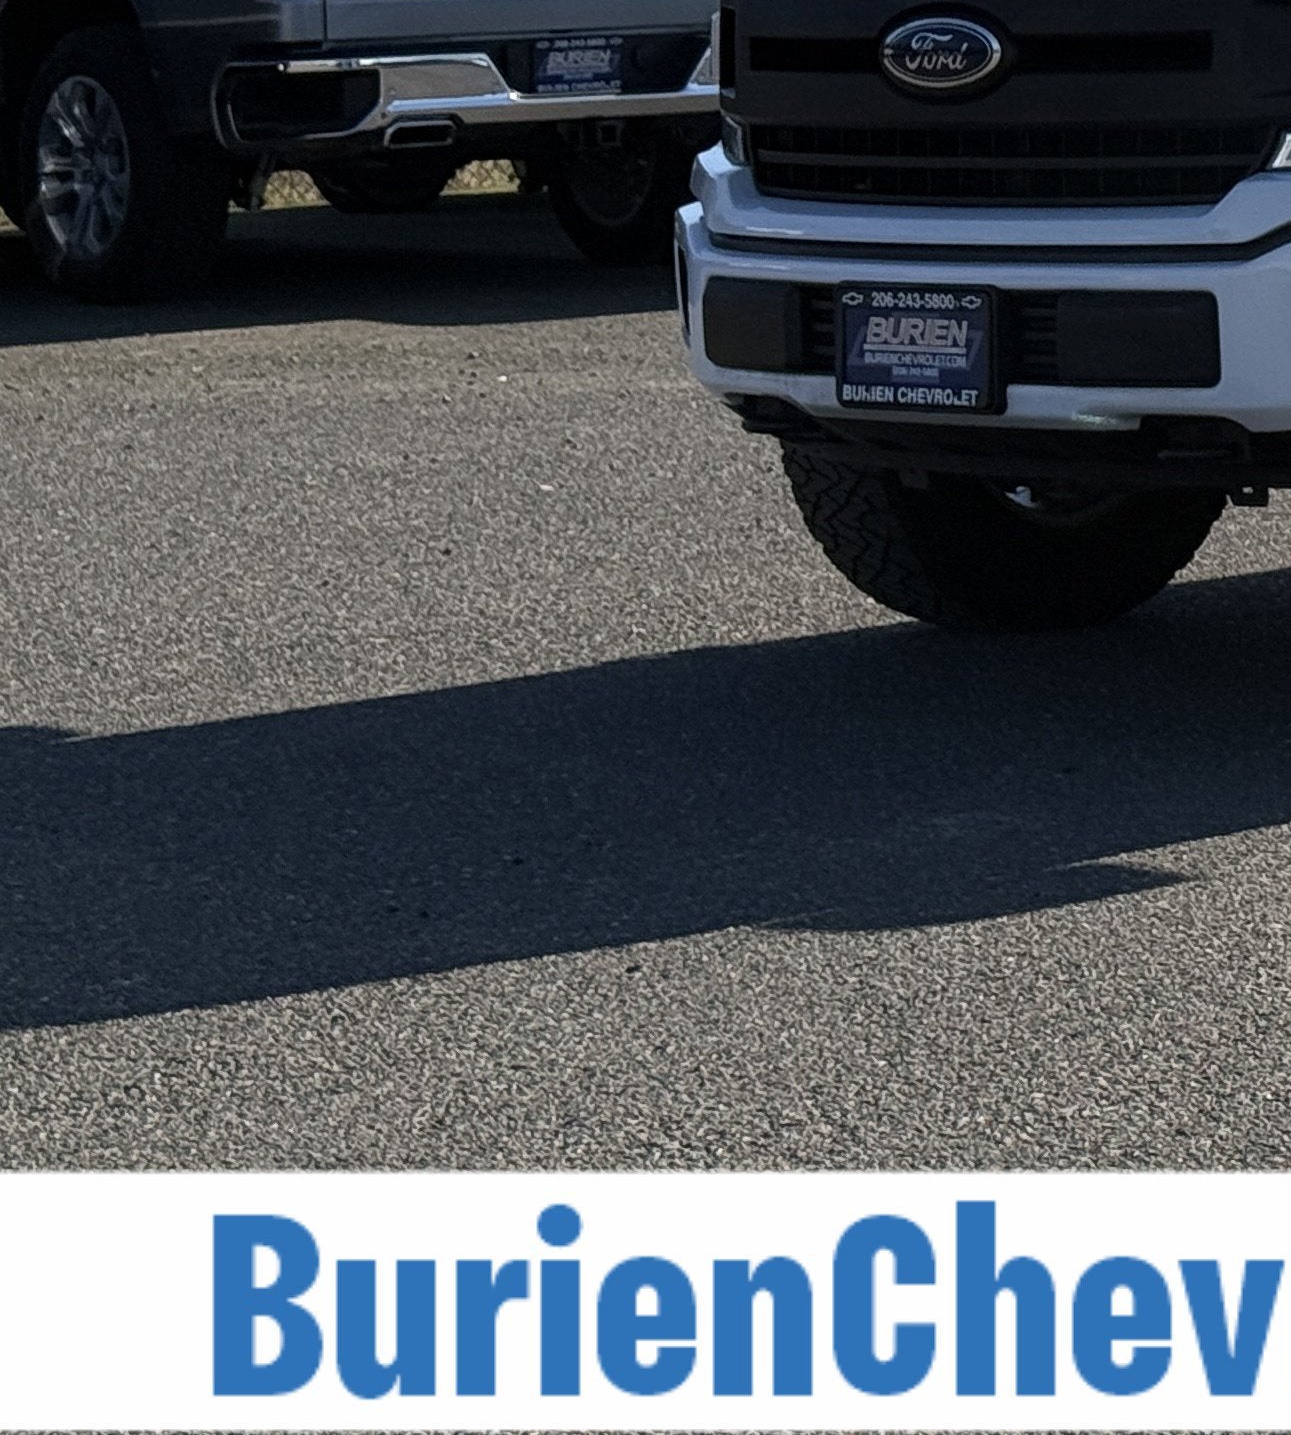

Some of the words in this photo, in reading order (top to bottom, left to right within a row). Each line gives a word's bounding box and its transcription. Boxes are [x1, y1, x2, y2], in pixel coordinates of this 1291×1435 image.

[905, 32, 970, 71] Ford
[871, 291, 955, 310] 206-243-5800
[866, 316, 968, 347] BURIEN
